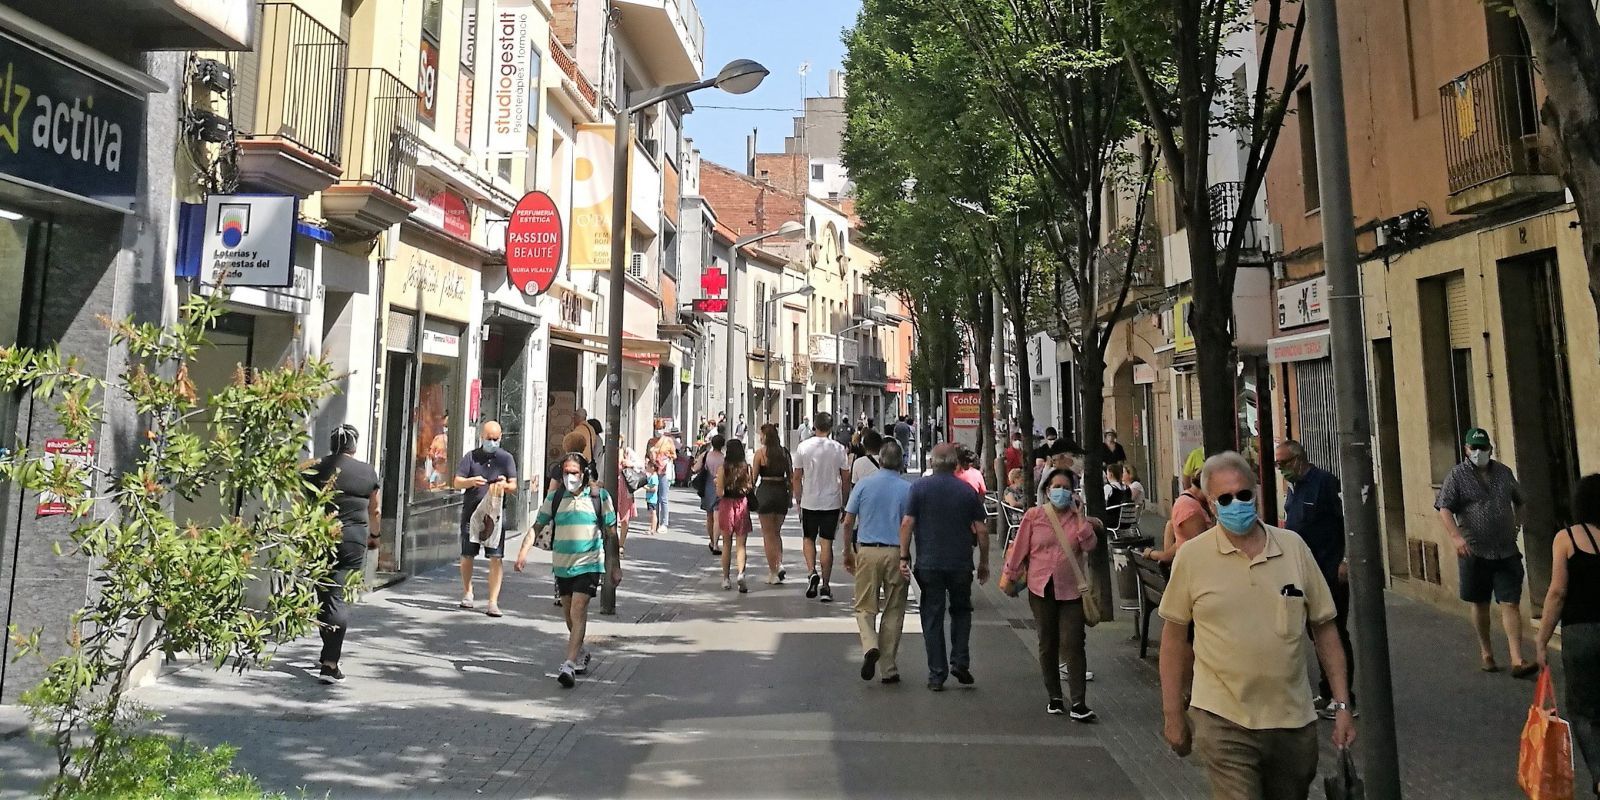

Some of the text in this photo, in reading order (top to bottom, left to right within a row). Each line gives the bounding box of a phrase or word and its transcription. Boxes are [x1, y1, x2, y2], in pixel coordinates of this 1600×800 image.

[33, 94, 122, 172] activa
[509, 232, 557, 243] PASSION
[252, 251, 258, 259] y
[213, 260, 270, 270] Apestas del
